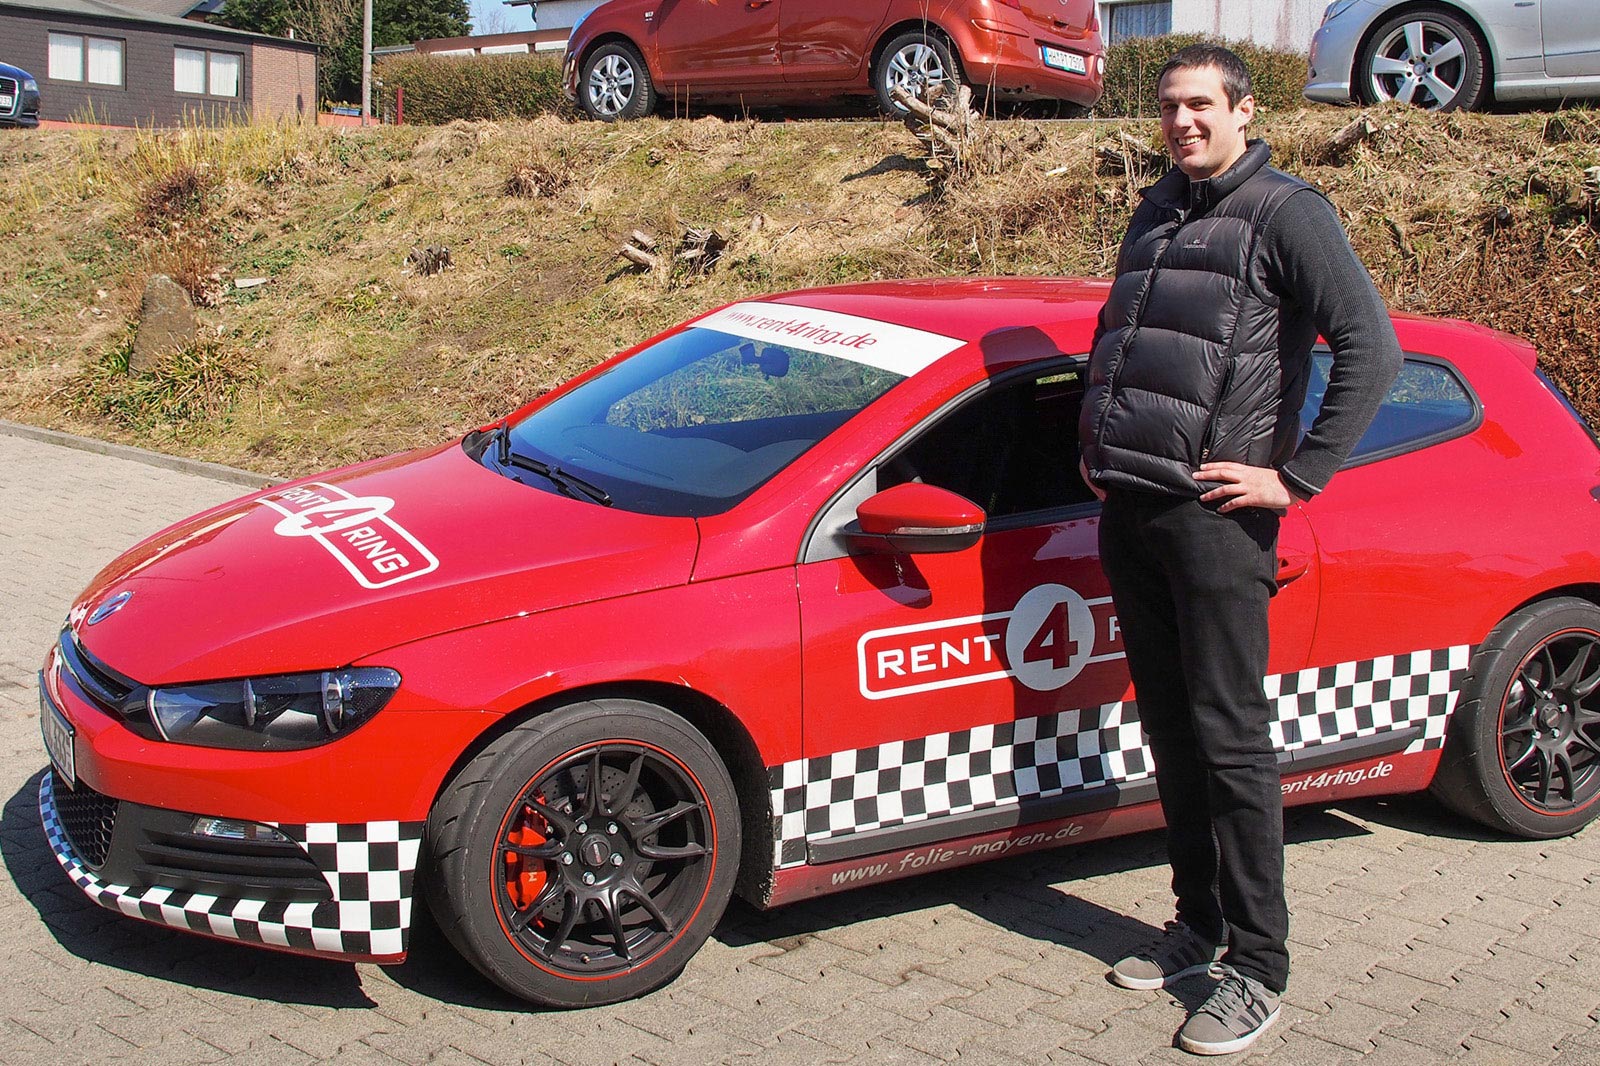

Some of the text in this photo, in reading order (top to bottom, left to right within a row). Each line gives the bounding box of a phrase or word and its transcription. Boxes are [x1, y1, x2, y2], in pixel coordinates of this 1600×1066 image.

[724, 312, 877, 350] www.rent4ring.de
[279, 487, 410, 574] RENT 4 RING
[877, 634, 1000, 679] RENT
[1023, 601, 1078, 670] 4
